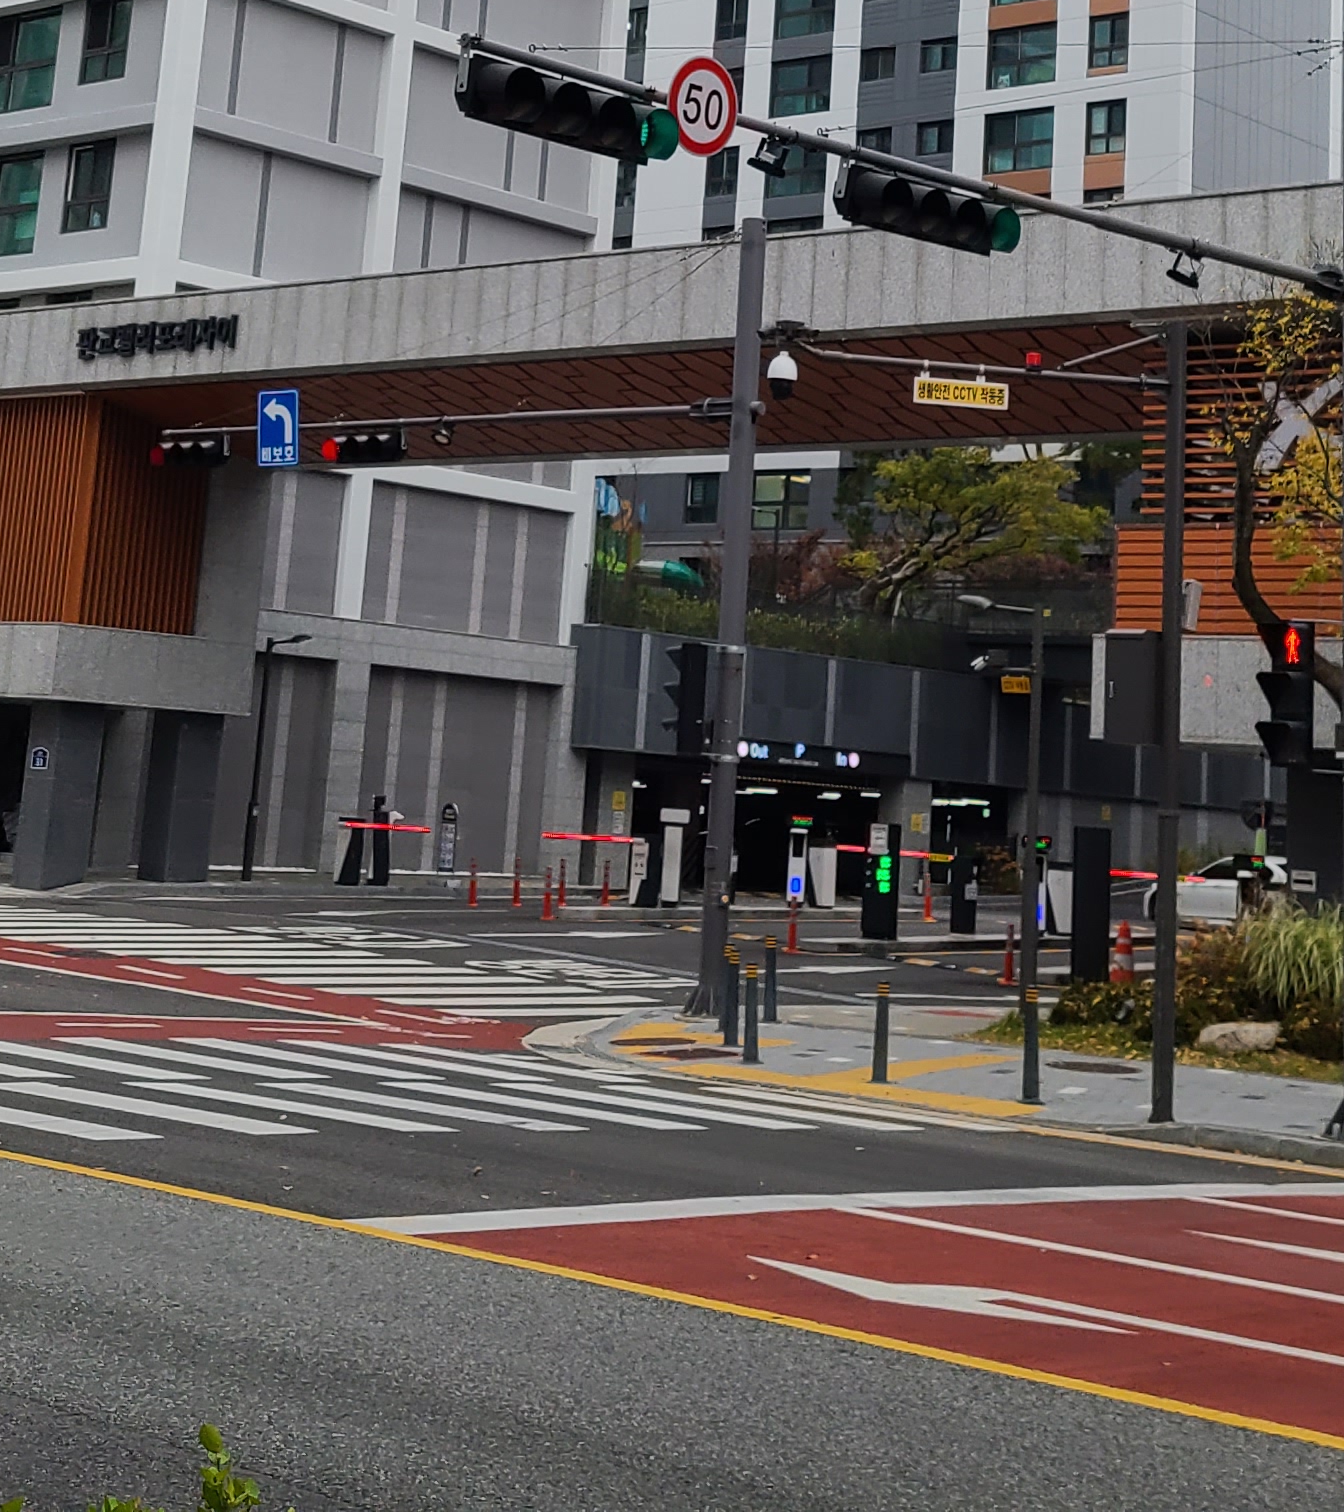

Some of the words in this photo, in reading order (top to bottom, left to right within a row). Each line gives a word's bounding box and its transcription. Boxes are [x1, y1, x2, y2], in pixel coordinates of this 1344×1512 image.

[682, 82, 723, 130] 50
[918, 381, 951, 401] 생활안전
[952, 385, 978, 402] CCTV
[980, 387, 1005, 405] 작동중
[261, 445, 295, 463] 비보호
[749, 742, 769, 759] Out
[794, 743, 806, 759] P
[835, 751, 848, 767] In
